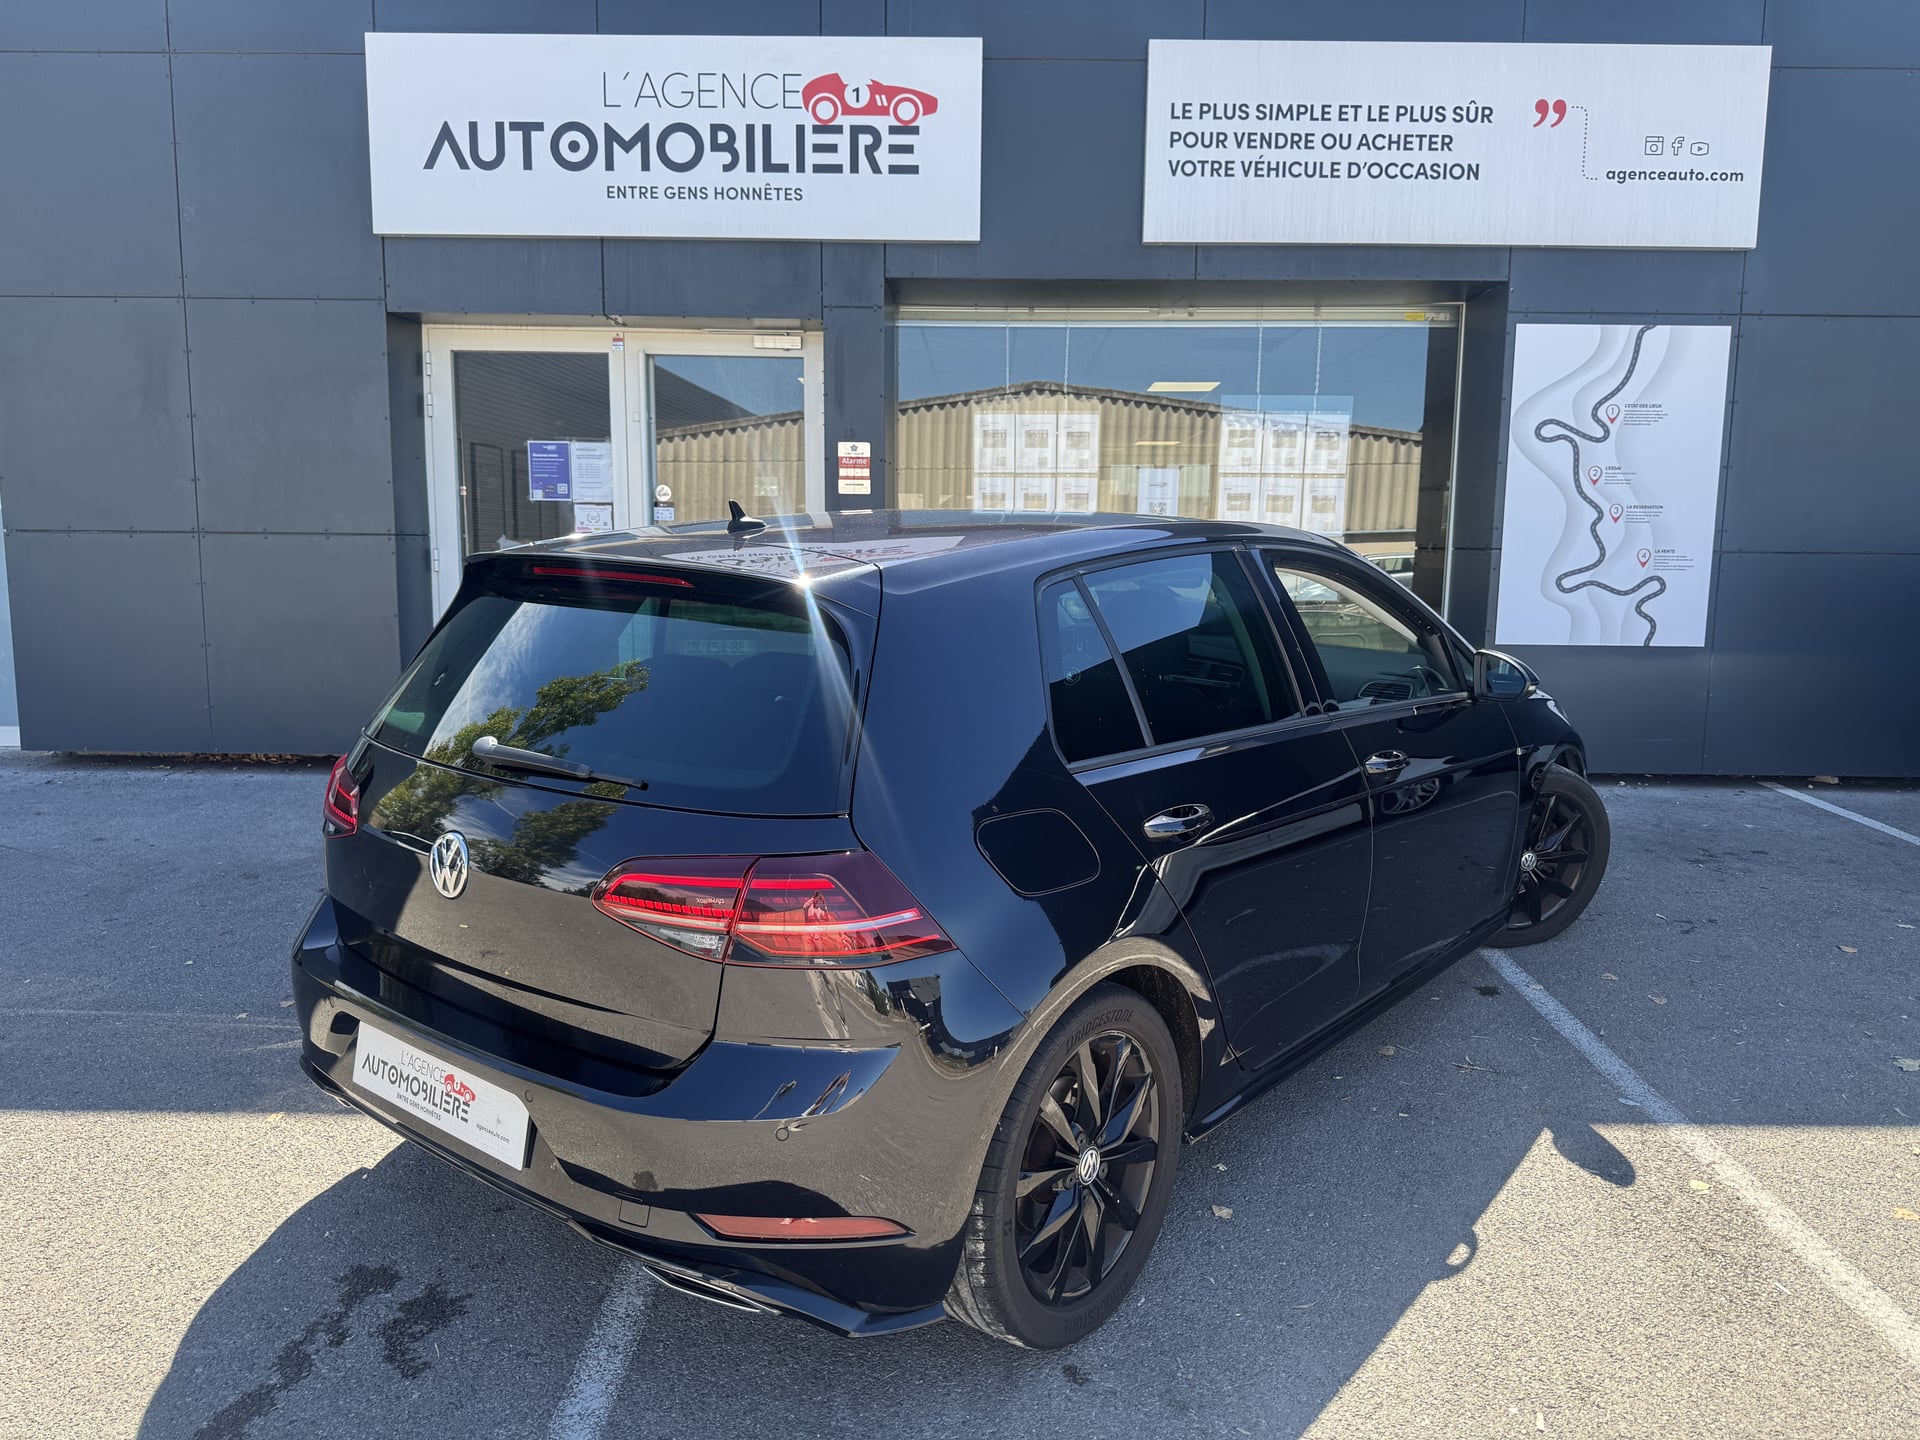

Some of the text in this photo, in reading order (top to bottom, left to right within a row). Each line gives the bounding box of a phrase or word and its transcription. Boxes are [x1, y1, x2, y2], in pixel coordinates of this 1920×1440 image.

[603, 71, 801, 110] L'AGENCE
[1170, 99, 1494, 124] LE PLUS SIMPLE ET LE PLUS SÛR
[1169, 131, 1454, 152] POUR VENDRE OU ACHETER
[1168, 155, 1480, 181] VOTRE VÉHICULE D'OCCASION
[1605, 168, 1744, 184] agenceauto.com
[606, 183, 803, 202] ENTRE GENS HONNÊTES
[842, 457, 867, 465] Alarme
[1592, 468, 1599, 477] 2
[1613, 506, 1620, 515] 3
